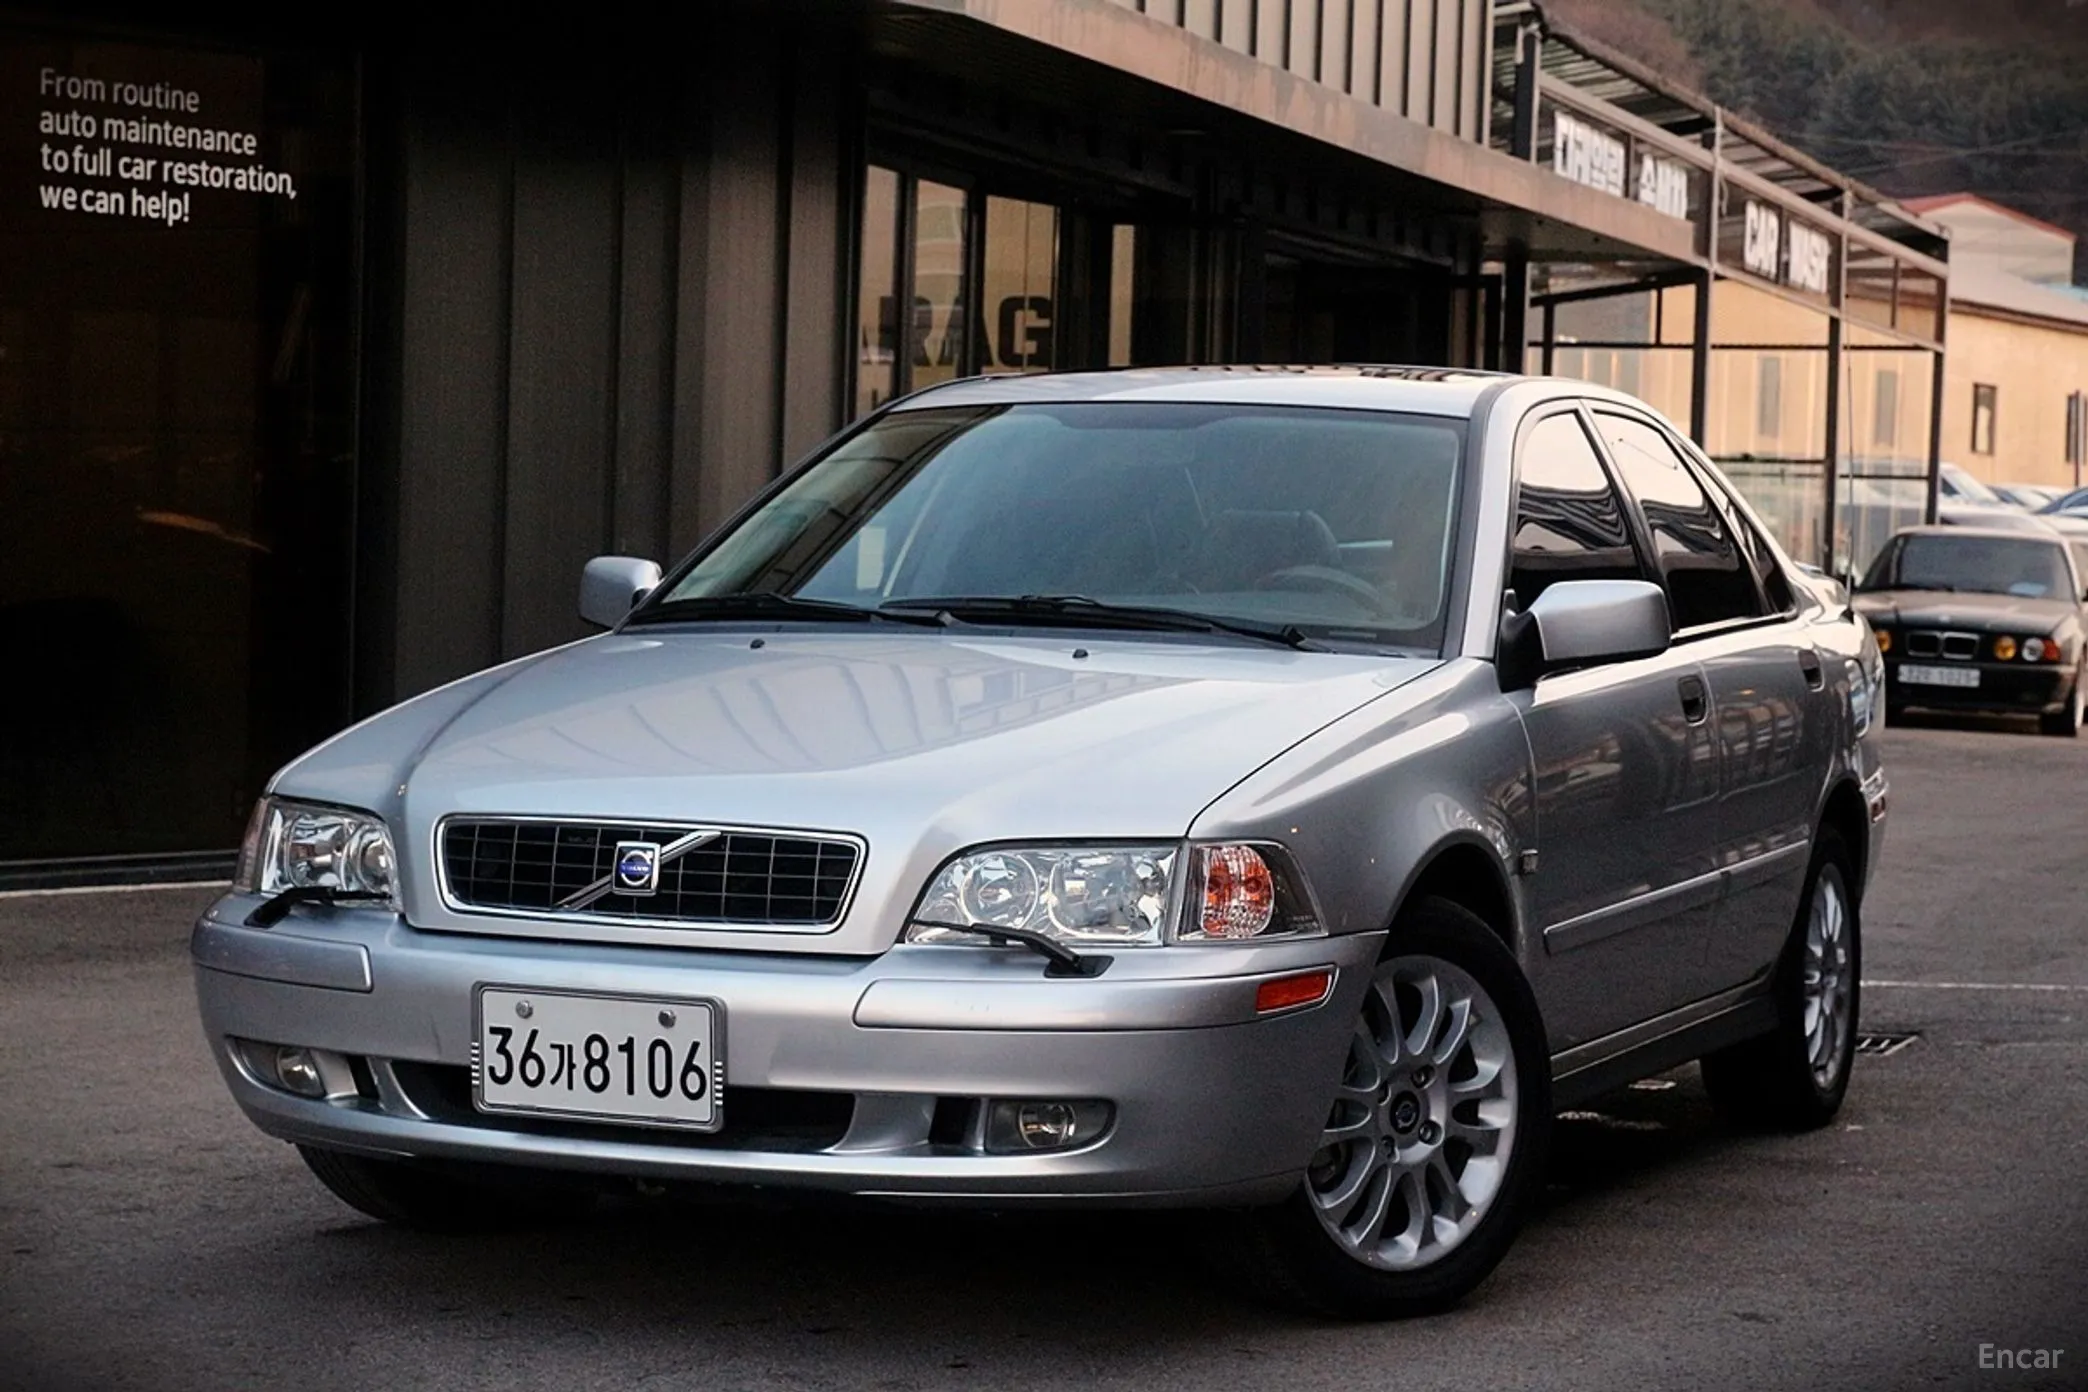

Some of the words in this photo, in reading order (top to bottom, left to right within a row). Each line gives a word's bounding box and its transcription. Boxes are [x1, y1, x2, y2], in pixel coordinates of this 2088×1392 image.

[40, 67, 105, 101] From
[112, 82, 200, 113] routine
[39, 109, 97, 139] auto
[103, 116, 257, 155] maintenance
[40, 143, 69, 173] to
[72, 145, 111, 177] full
[118, 156, 157, 181] car
[163, 160, 297, 200] restoration,
[40, 184, 77, 211] we
[81, 187, 125, 216] can
[131, 187, 190, 227] help!
[1743, 200, 1779, 283] CAR
[1788, 218, 1831, 295] WASH
[488, 1026, 707, 1101] 36가8106
